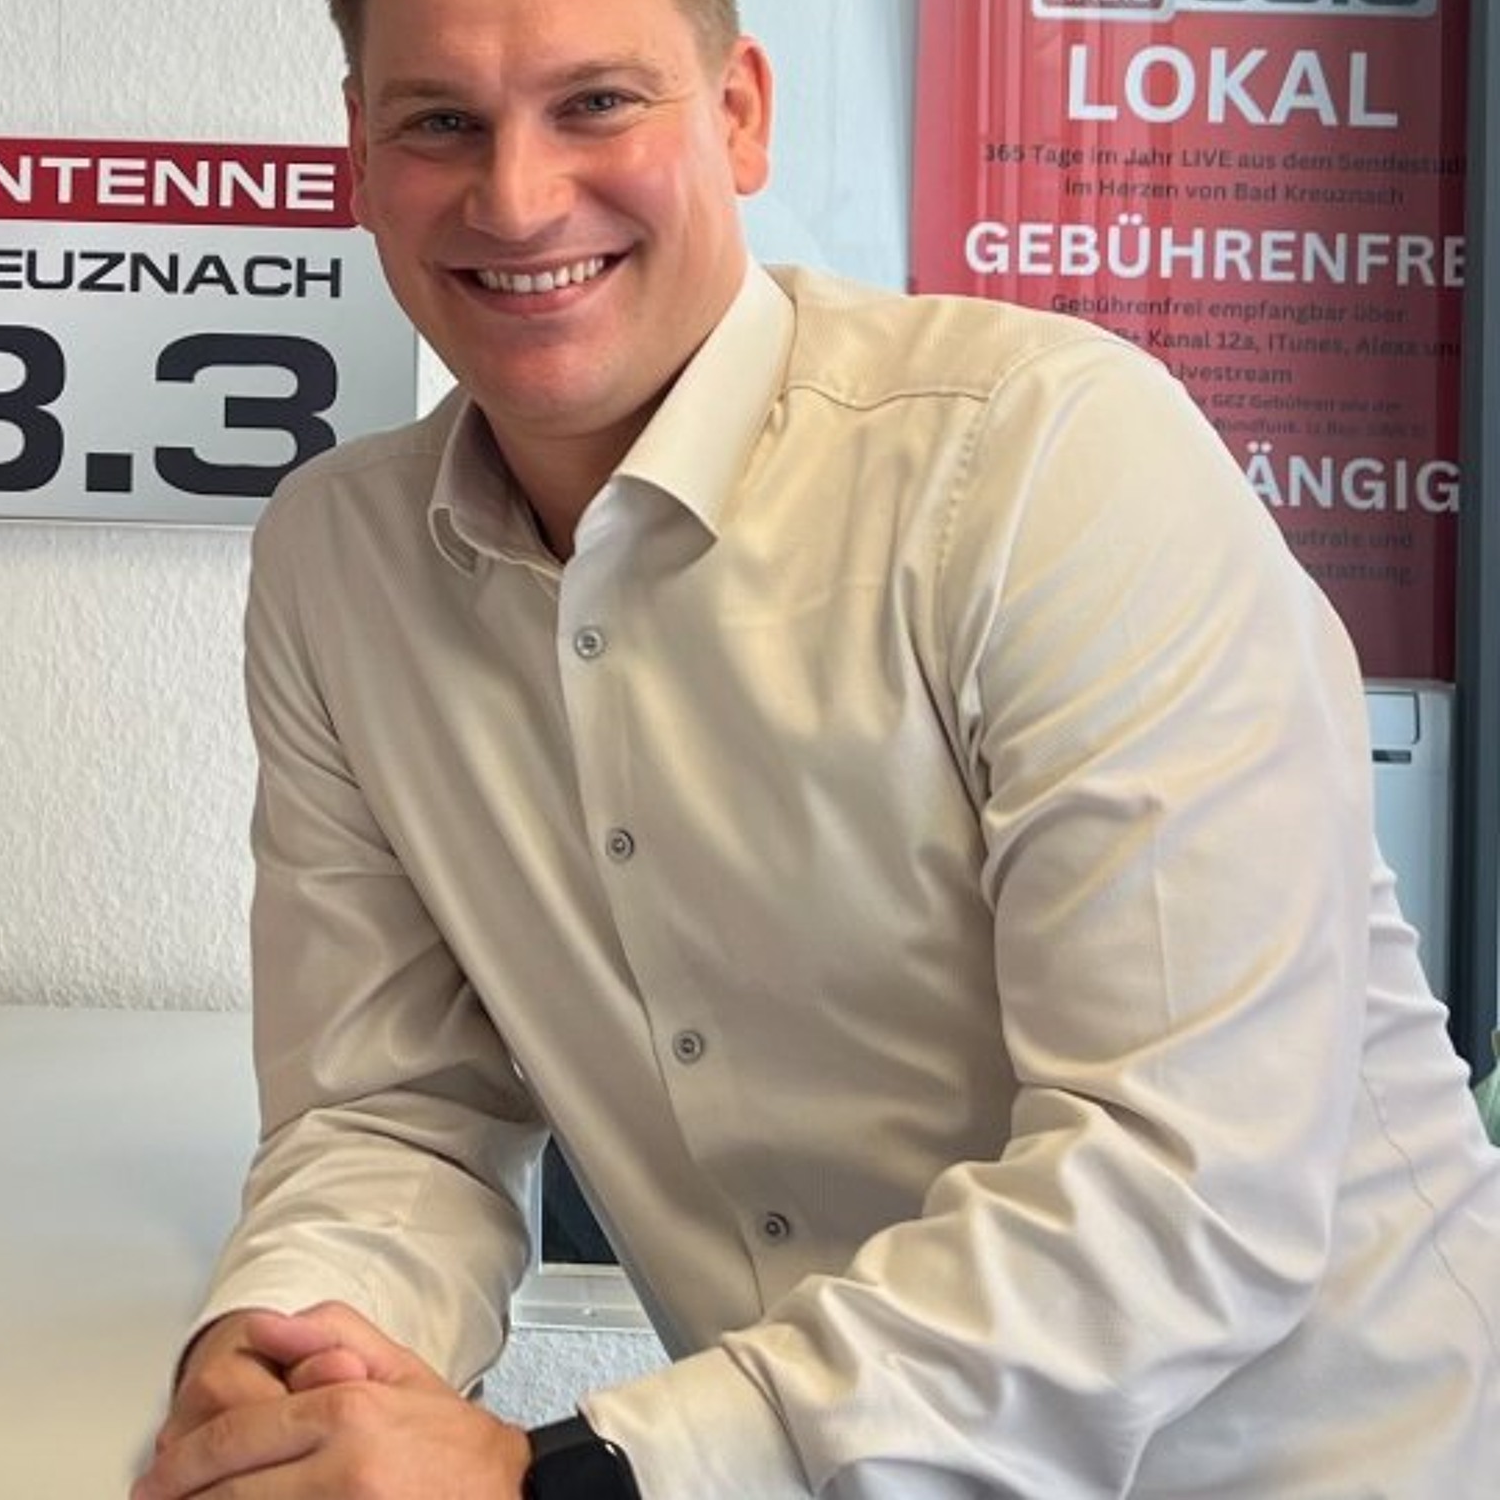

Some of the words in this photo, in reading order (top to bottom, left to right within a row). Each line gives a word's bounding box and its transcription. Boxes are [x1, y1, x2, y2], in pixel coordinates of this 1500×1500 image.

[1067, 44, 1398, 128] LOKAL
[985, 144, 1026, 163] 365
[1032, 145, 1084, 168] Tage
[1124, 148, 1174, 167] Jahr
[1181, 148, 1233, 168] LIVE
[1238, 152, 1277, 170] aus
[1283, 151, 1333, 170] dem
[1099, 178, 1178, 199] Herzen
[1186, 184, 1228, 199] von
[1235, 181, 1276, 202] Bad
[965, 214, 1465, 287] GEBÜHRENFRE
[1052, 294, 1201, 318] Gebührenfrei
[1208, 297, 1347, 326] empfangbar
[1148, 329, 1211, 349] Kanal
